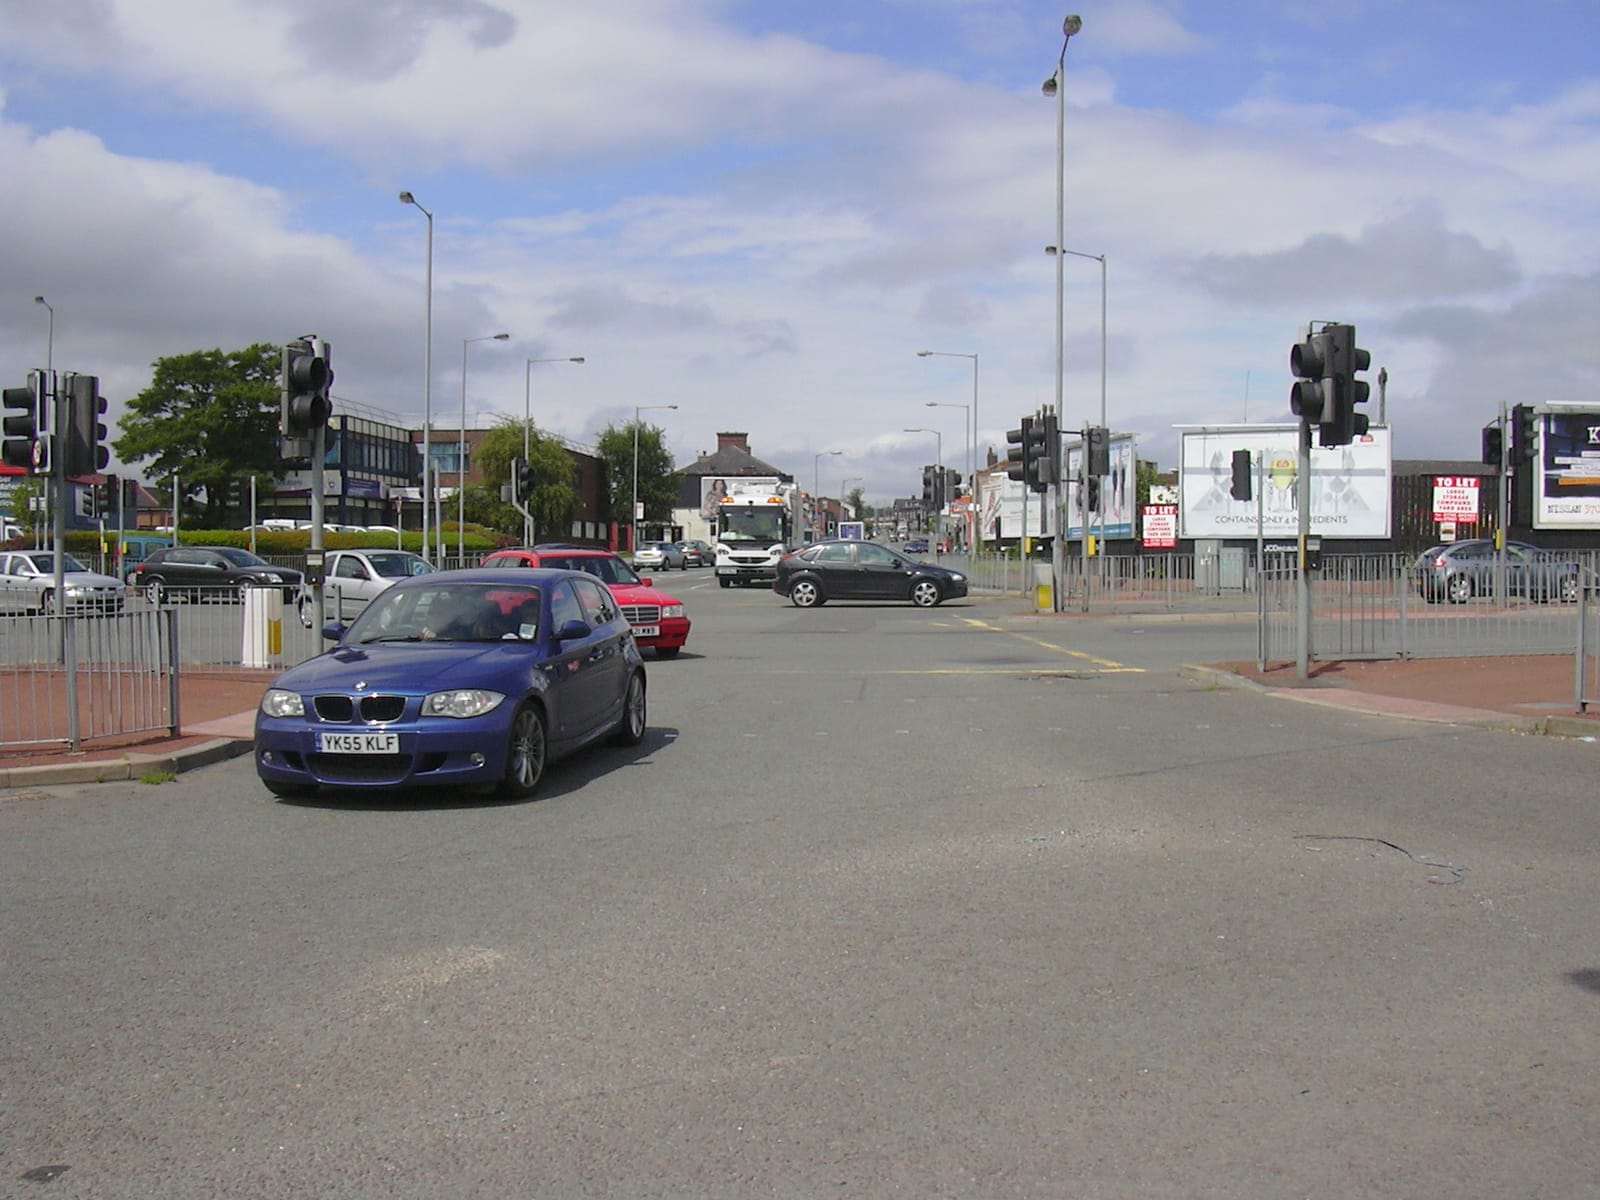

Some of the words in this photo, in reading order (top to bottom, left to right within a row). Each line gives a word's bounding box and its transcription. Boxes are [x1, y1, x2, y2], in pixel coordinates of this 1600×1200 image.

[1437, 477, 1452, 487] TO
[1456, 477, 1476, 487] LET
[1144, 506, 1157, 515] TO
[1159, 506, 1174, 515] LET
[1547, 504, 1582, 514] NISSAN
[1215, 516, 1259, 524] CONTAINS
[1261, 516, 1283, 524] ONLY
[1292, 516, 1348, 524] INEDIENTS
[324, 735, 362, 751] YK55
[366, 735, 395, 751] KLF
